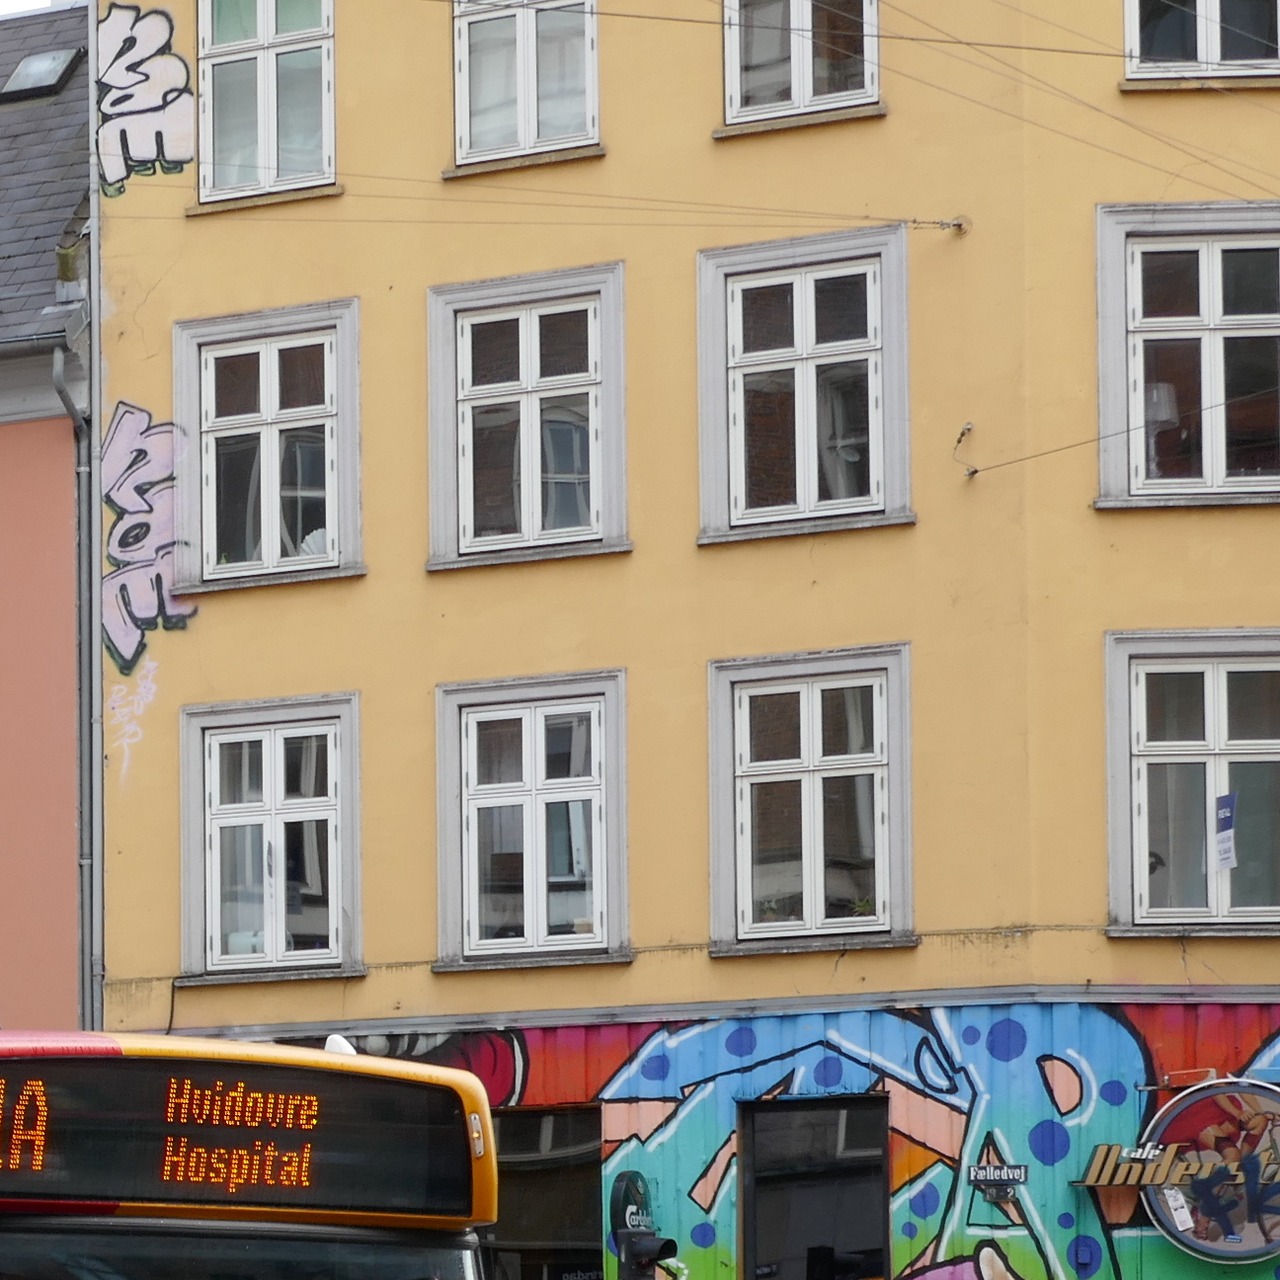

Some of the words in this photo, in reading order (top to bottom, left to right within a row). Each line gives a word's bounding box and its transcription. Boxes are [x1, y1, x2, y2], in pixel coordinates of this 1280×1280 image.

[165, 1077, 320, 1131] Hvidovre
[162, 1135, 312, 1193] Hospital
[970, 1166, 1026, 1182] Fælledvej
